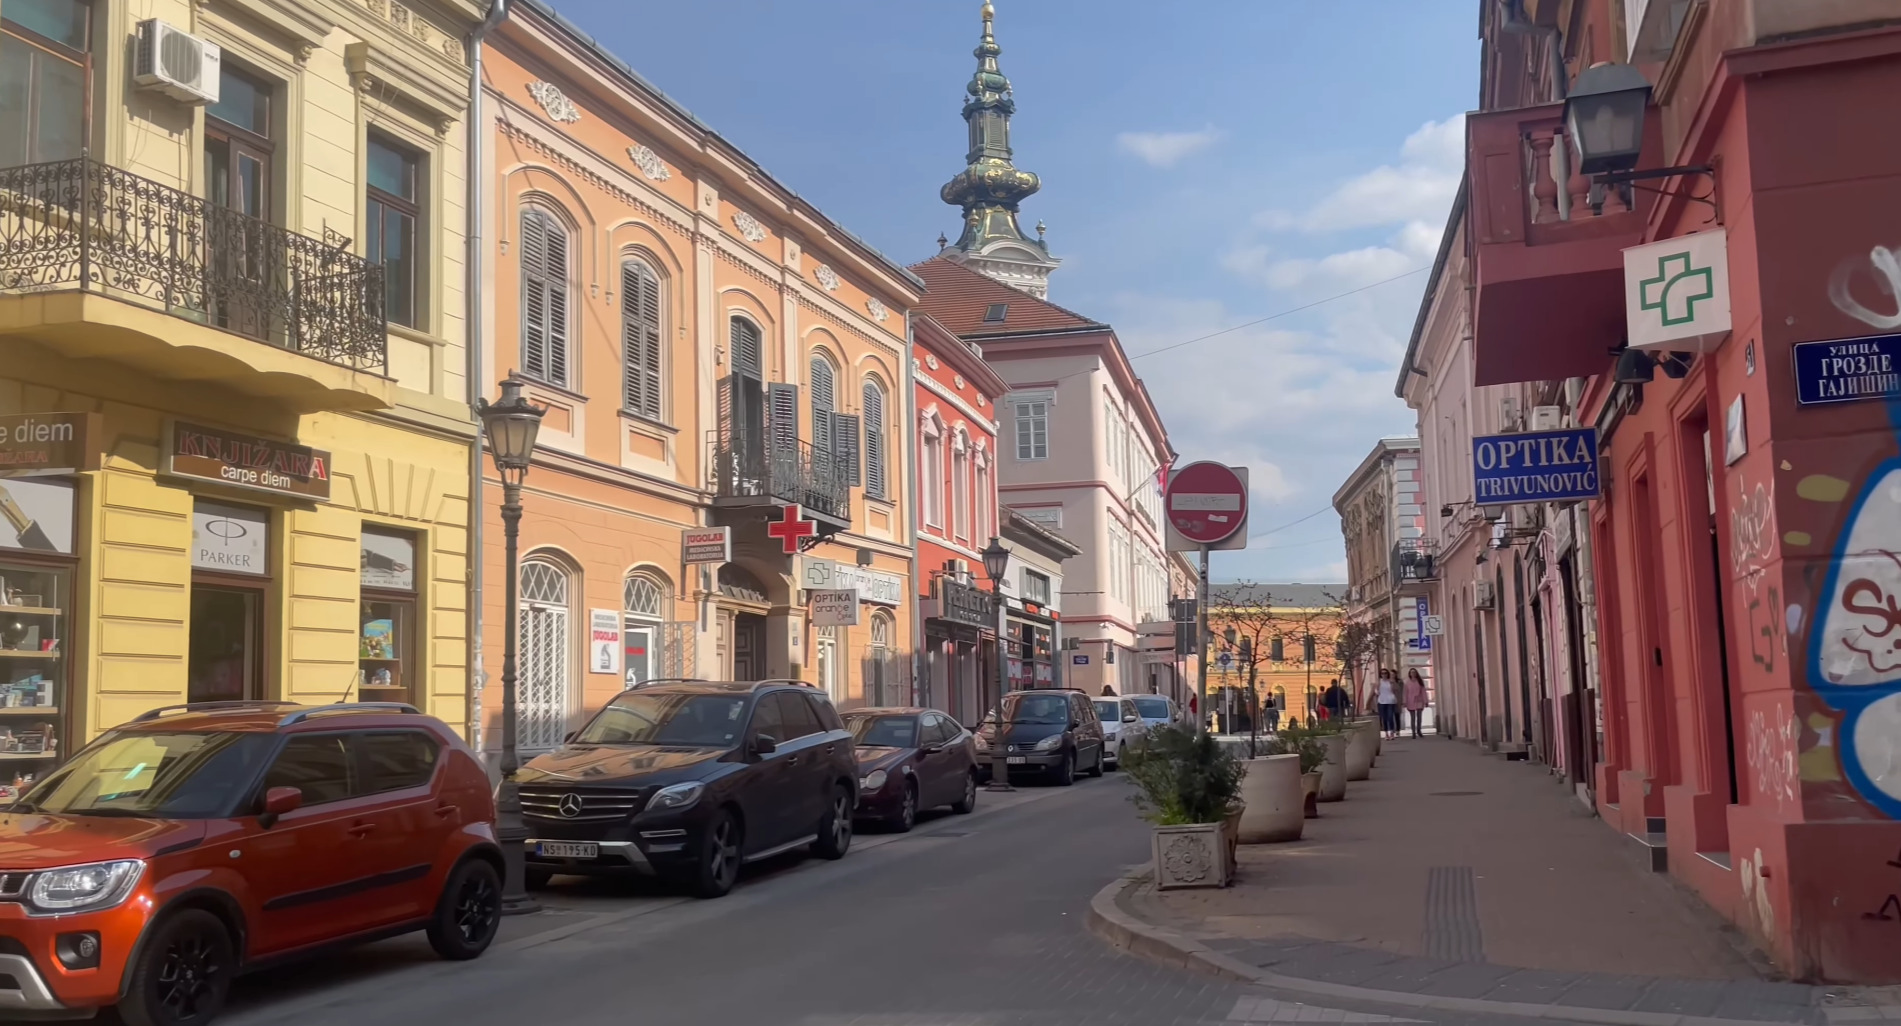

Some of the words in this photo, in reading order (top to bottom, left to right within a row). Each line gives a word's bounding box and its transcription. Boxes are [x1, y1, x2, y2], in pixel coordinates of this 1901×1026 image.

[1829, 342, 1880, 357] УЛИЦА
[1821, 354, 1892, 376] ГРОЗДЕ
[15, 418, 73, 443] diem
[178, 431, 328, 481] KNJIŽARA
[1476, 435, 1593, 470] OPTIKA
[220, 465, 258, 484] carpe
[260, 470, 291, 488] diem
[1477, 463, 1596, 497] TRIVUNOVIĆ
[200, 549, 250, 567] PARKER
